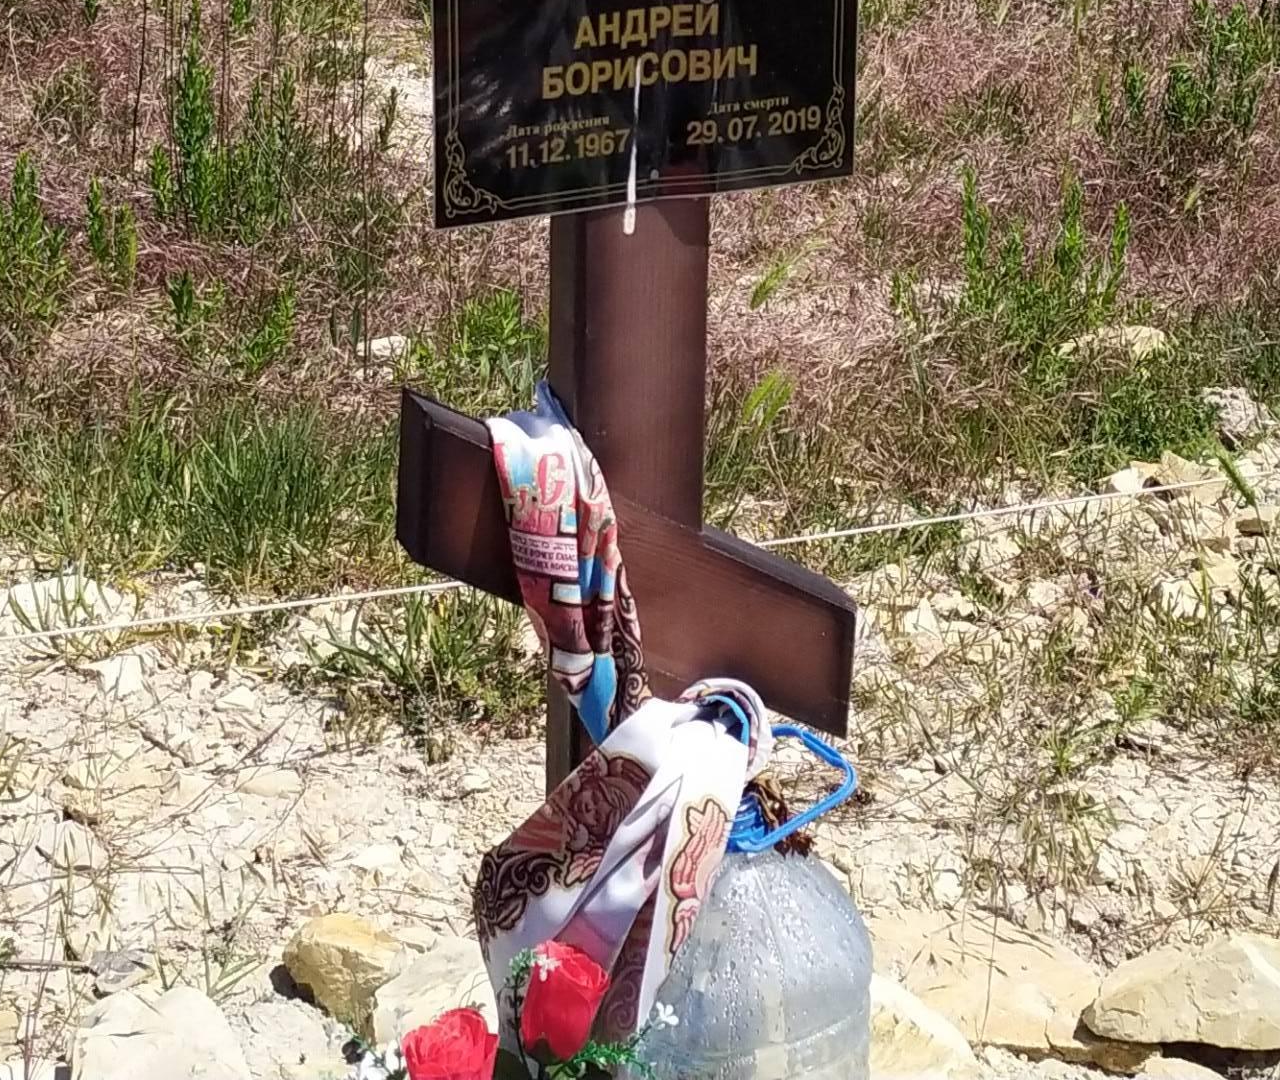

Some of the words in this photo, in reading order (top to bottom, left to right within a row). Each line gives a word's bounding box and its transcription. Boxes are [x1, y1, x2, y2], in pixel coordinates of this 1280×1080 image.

[541, 44, 758, 100] БОРИСОВИЧ
[708, 101, 741, 115] Дата
[743, 96, 790, 111] смерти
[506, 124, 540, 138] Дата
